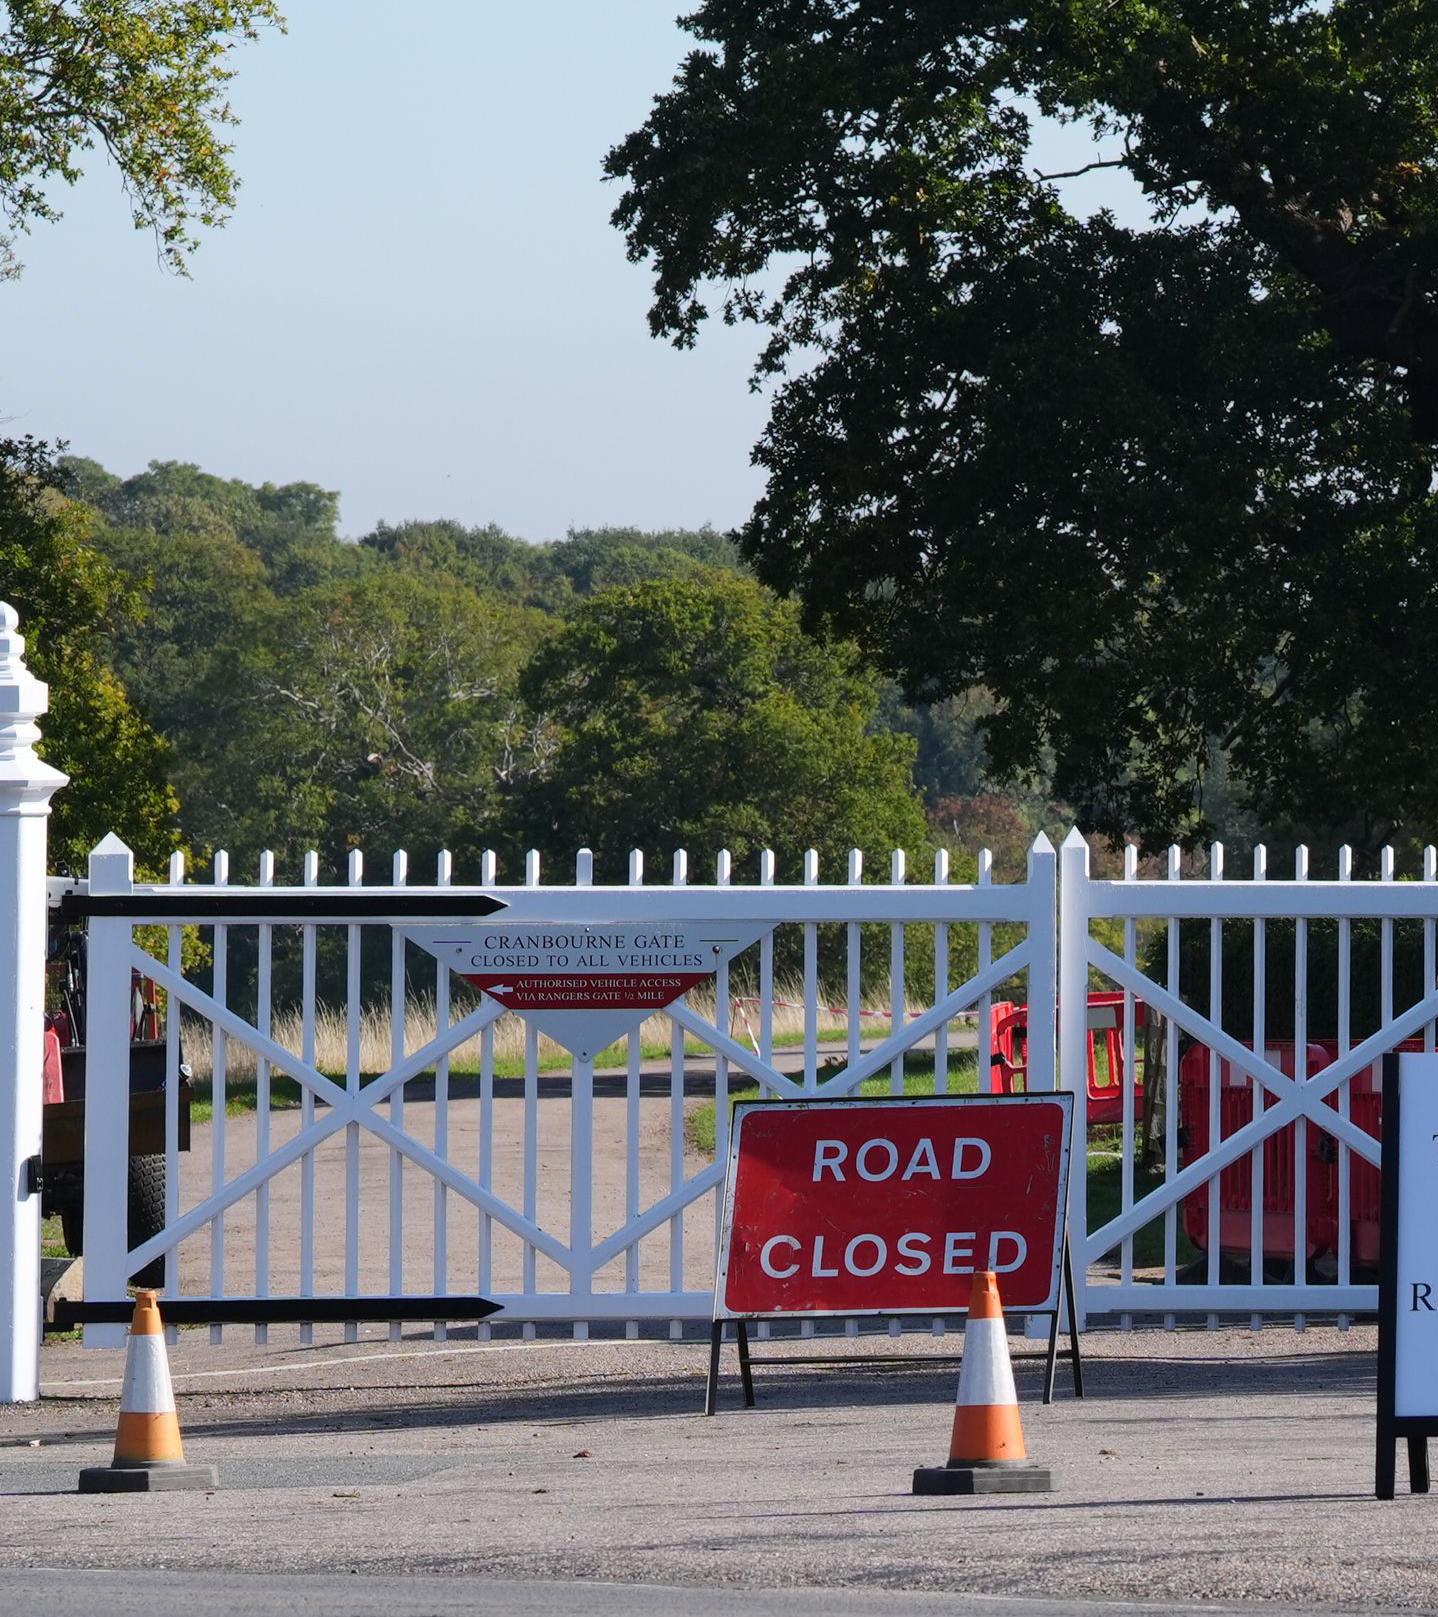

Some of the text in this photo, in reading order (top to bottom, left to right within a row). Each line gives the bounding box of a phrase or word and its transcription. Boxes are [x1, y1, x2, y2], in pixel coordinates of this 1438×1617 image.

[484, 934, 686, 950] CRANBOURNE GATE
[471, 953, 703, 968] CLOSED TO ALL VEHICLES
[516, 978, 681, 988] AUTHORISED VEHICLE ACCESS
[516, 992, 536, 1001] VIA
[538, 991, 590, 1001] RANGERS
[592, 991, 621, 1001] GATE
[637, 991, 665, 1000] MILE
[812, 1137, 992, 1183] ROAD
[760, 1230, 1027, 1280] CLOSED
